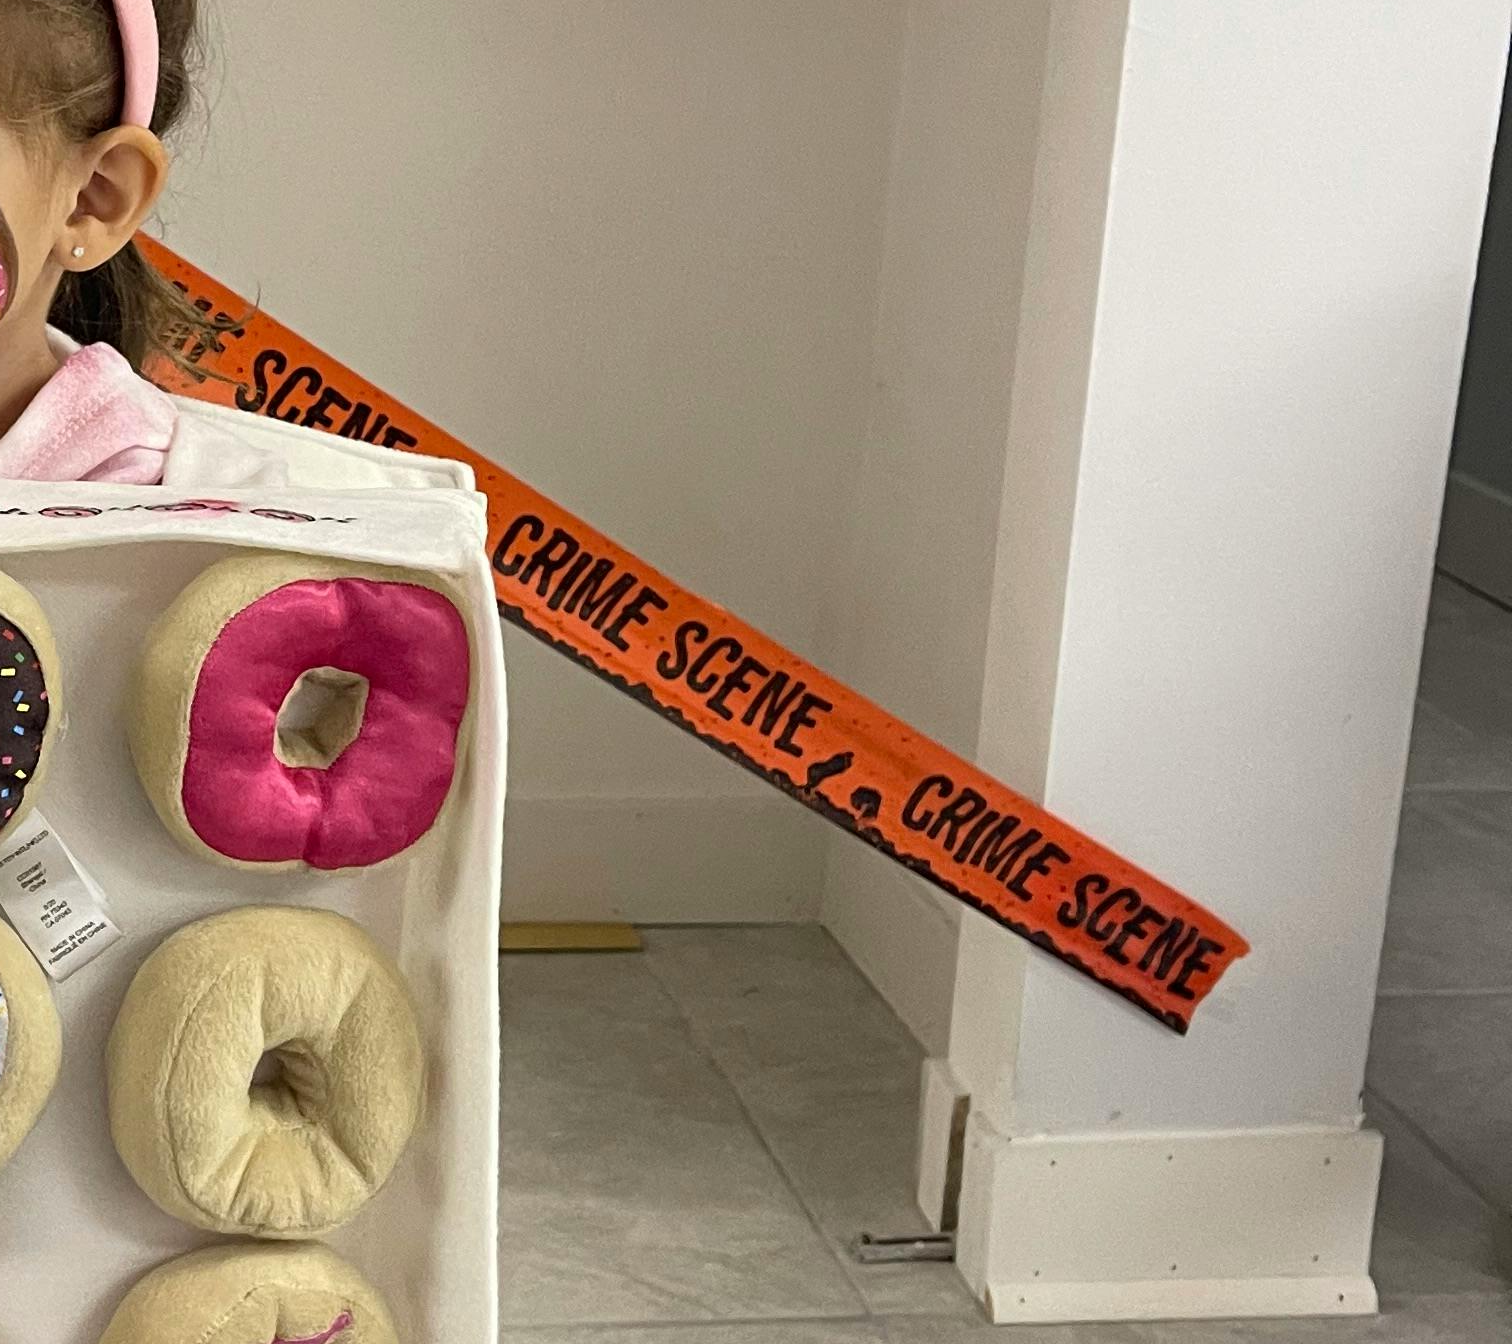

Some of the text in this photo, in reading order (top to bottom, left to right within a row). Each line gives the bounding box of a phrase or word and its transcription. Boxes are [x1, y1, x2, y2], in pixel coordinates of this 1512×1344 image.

[492, 514, 665, 654] CRIME
[656, 619, 833, 759] SCENE
[900, 772, 1071, 905] CRIME
[1056, 872, 1227, 1002] SCENE
